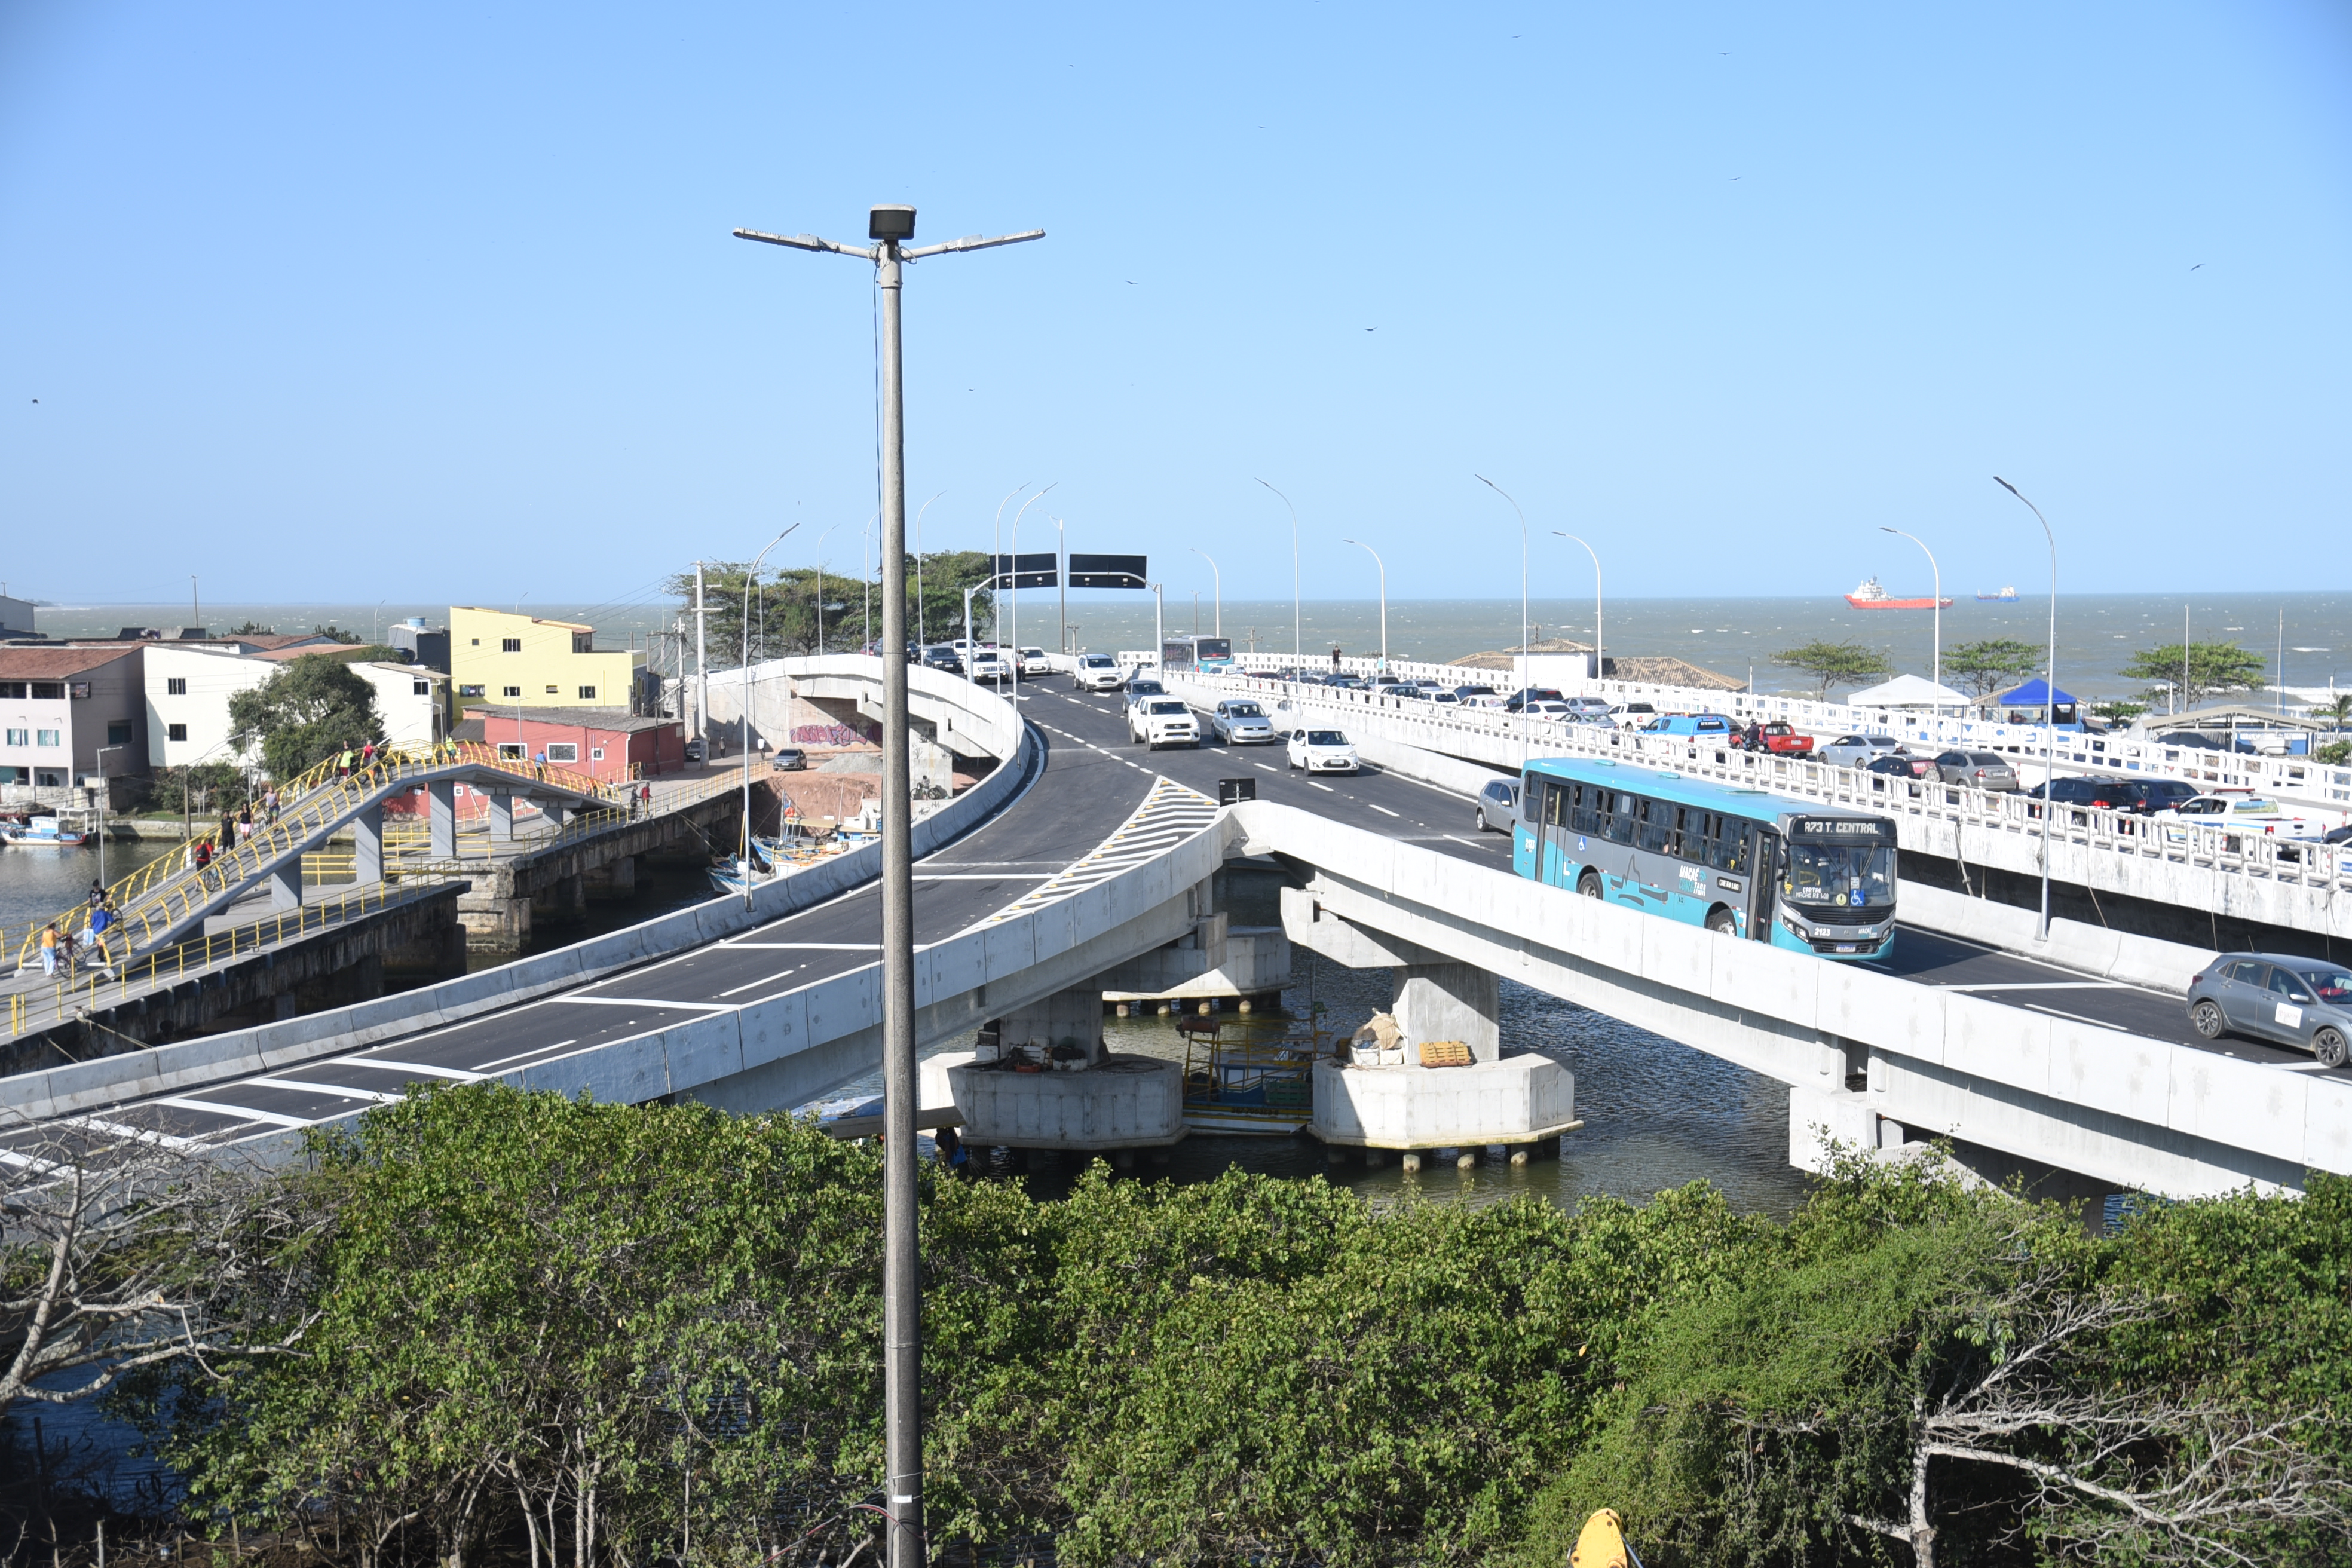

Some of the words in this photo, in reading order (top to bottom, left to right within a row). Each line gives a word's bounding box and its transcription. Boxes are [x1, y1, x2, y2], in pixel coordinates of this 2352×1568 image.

[1805, 822, 1823, 832] A73
[1825, 822, 1833, 833] T.
[1836, 822, 1879, 834] CENTRAL
[1525, 838, 1535, 849] 2123
[1679, 865, 1699, 881] MACAÉ
[1814, 927, 1831, 936] 2123
